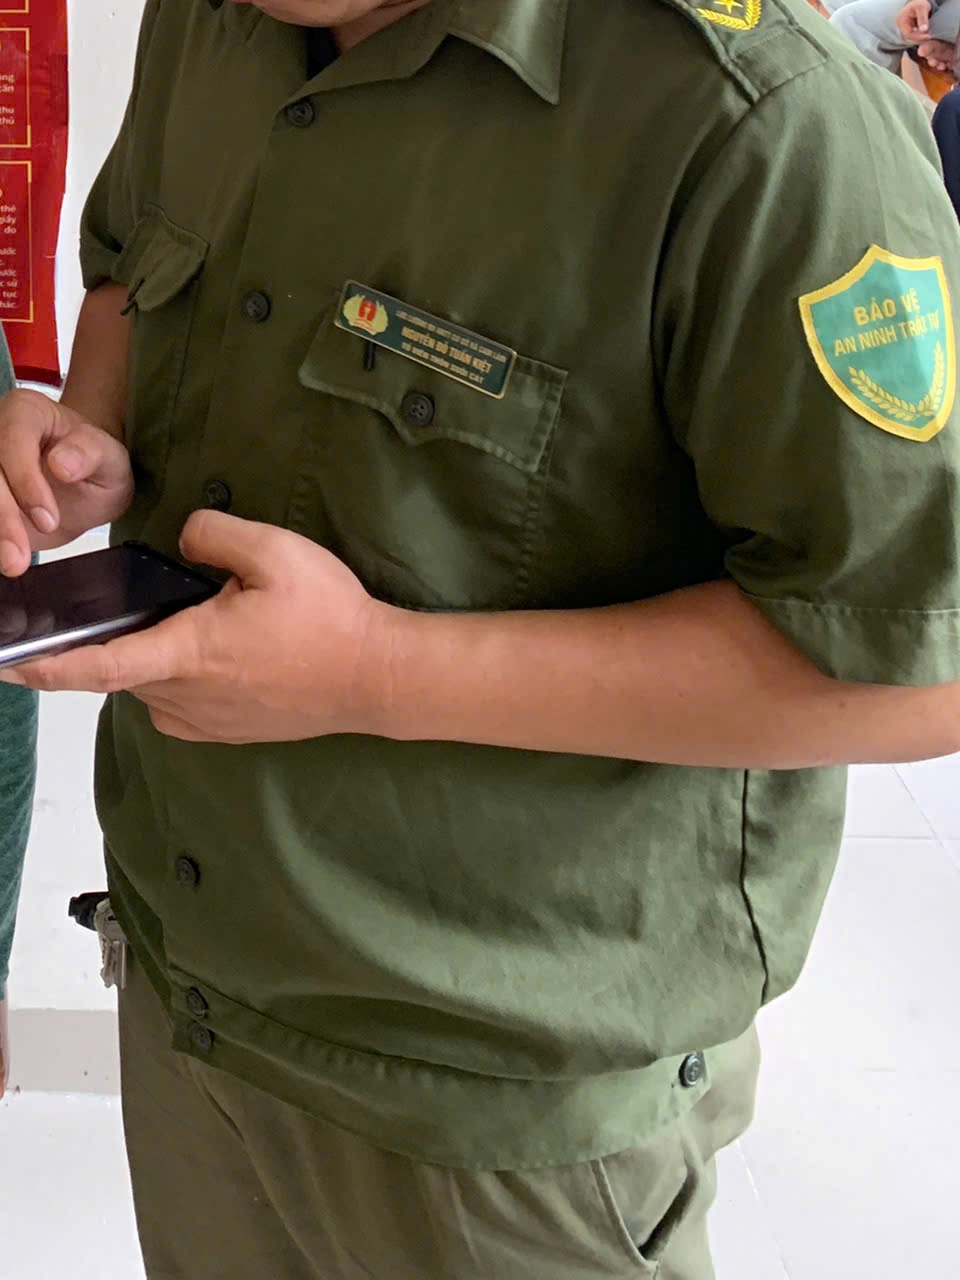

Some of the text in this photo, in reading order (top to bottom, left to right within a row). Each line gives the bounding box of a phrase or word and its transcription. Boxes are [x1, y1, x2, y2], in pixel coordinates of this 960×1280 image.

[4, 226, 16, 234] do
[854, 297, 896, 326] BẢO
[834, 335, 857, 357] AN
[858, 325, 897, 350] NINH
